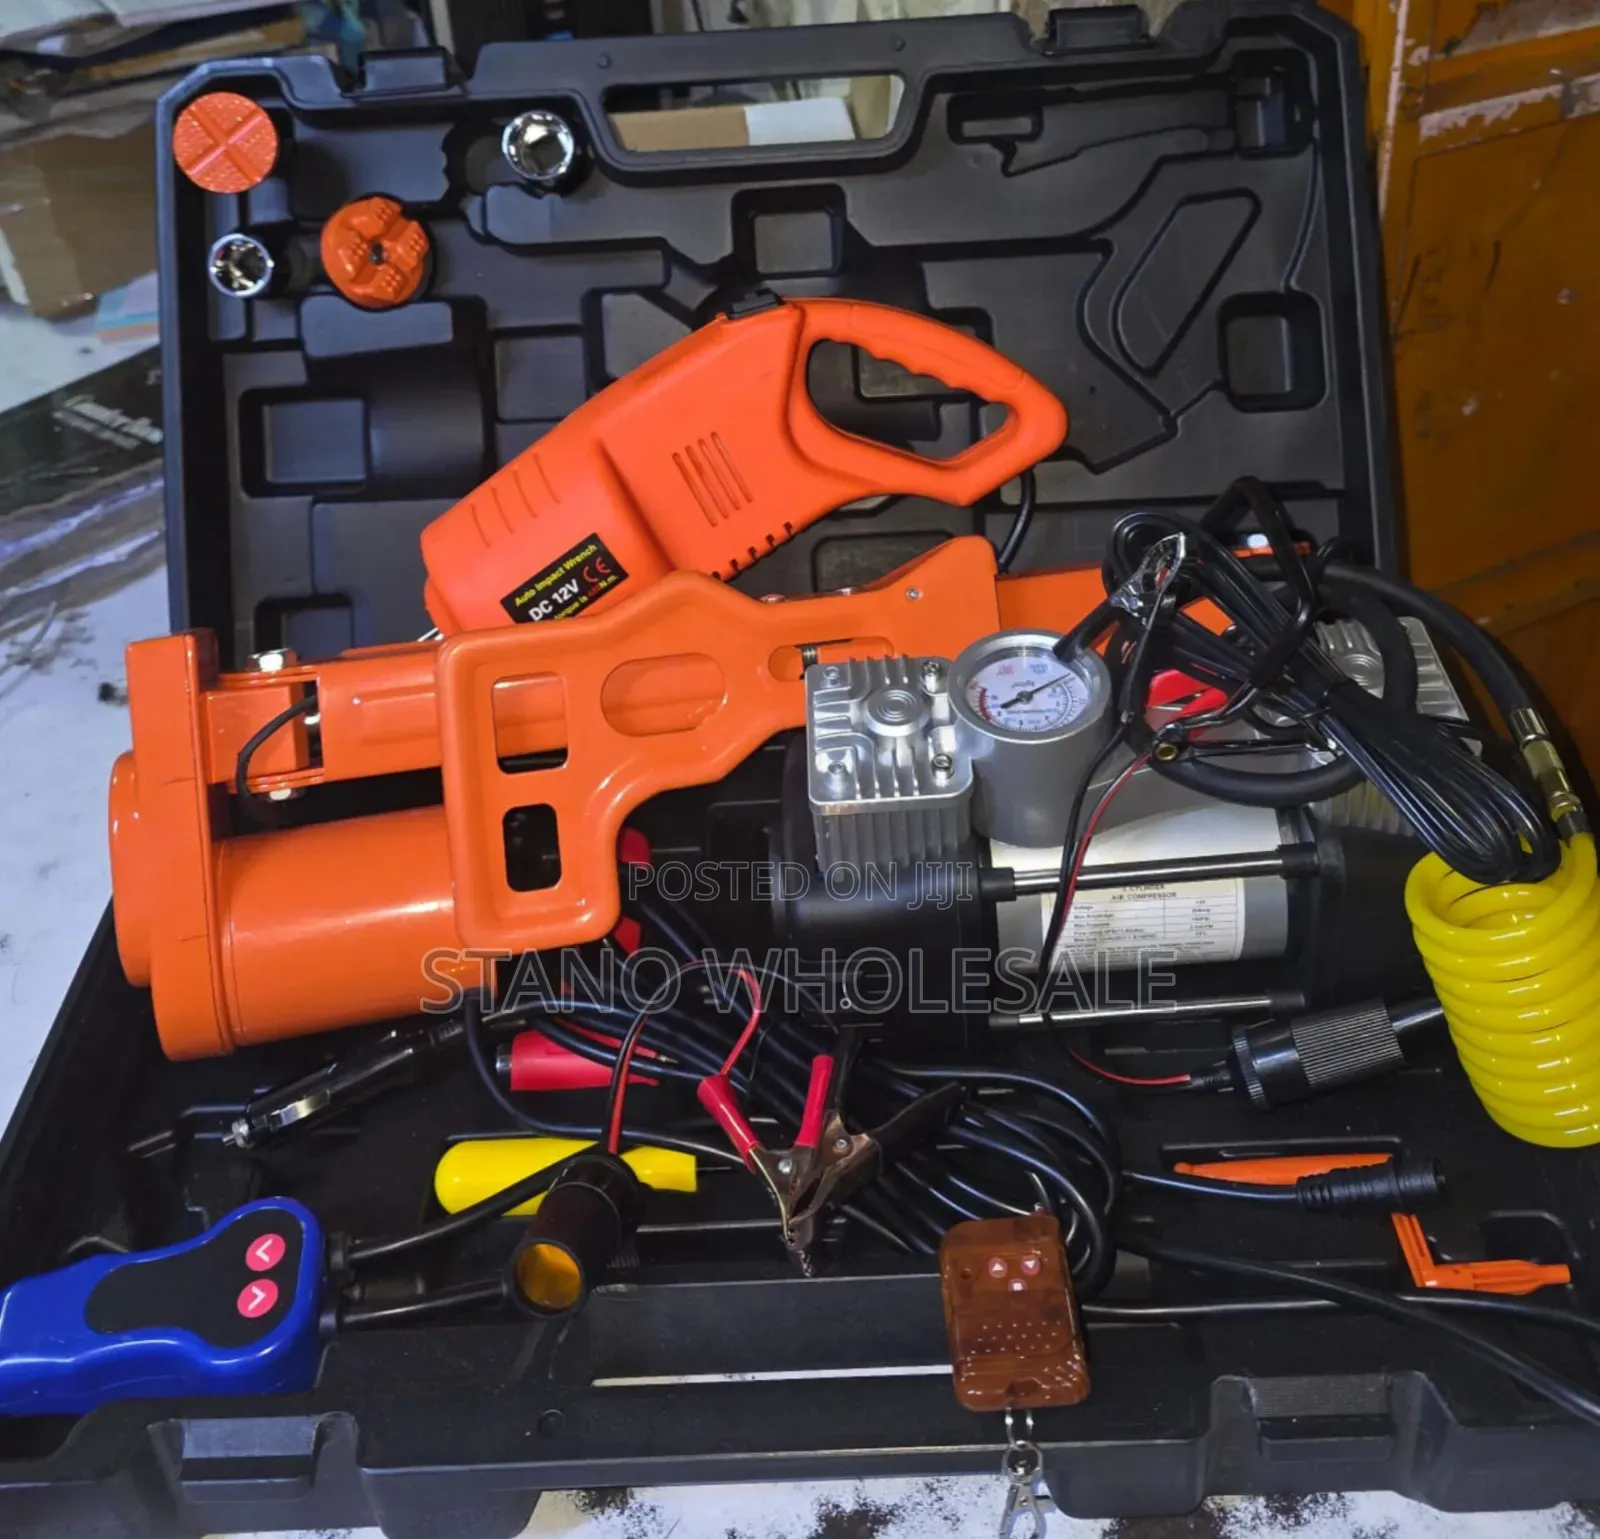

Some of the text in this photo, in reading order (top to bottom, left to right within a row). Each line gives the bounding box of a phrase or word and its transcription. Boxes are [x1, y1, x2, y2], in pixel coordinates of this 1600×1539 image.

[514, 544, 597, 606] Auto Impact Wrench
[528, 578, 580, 621] DC 12V
